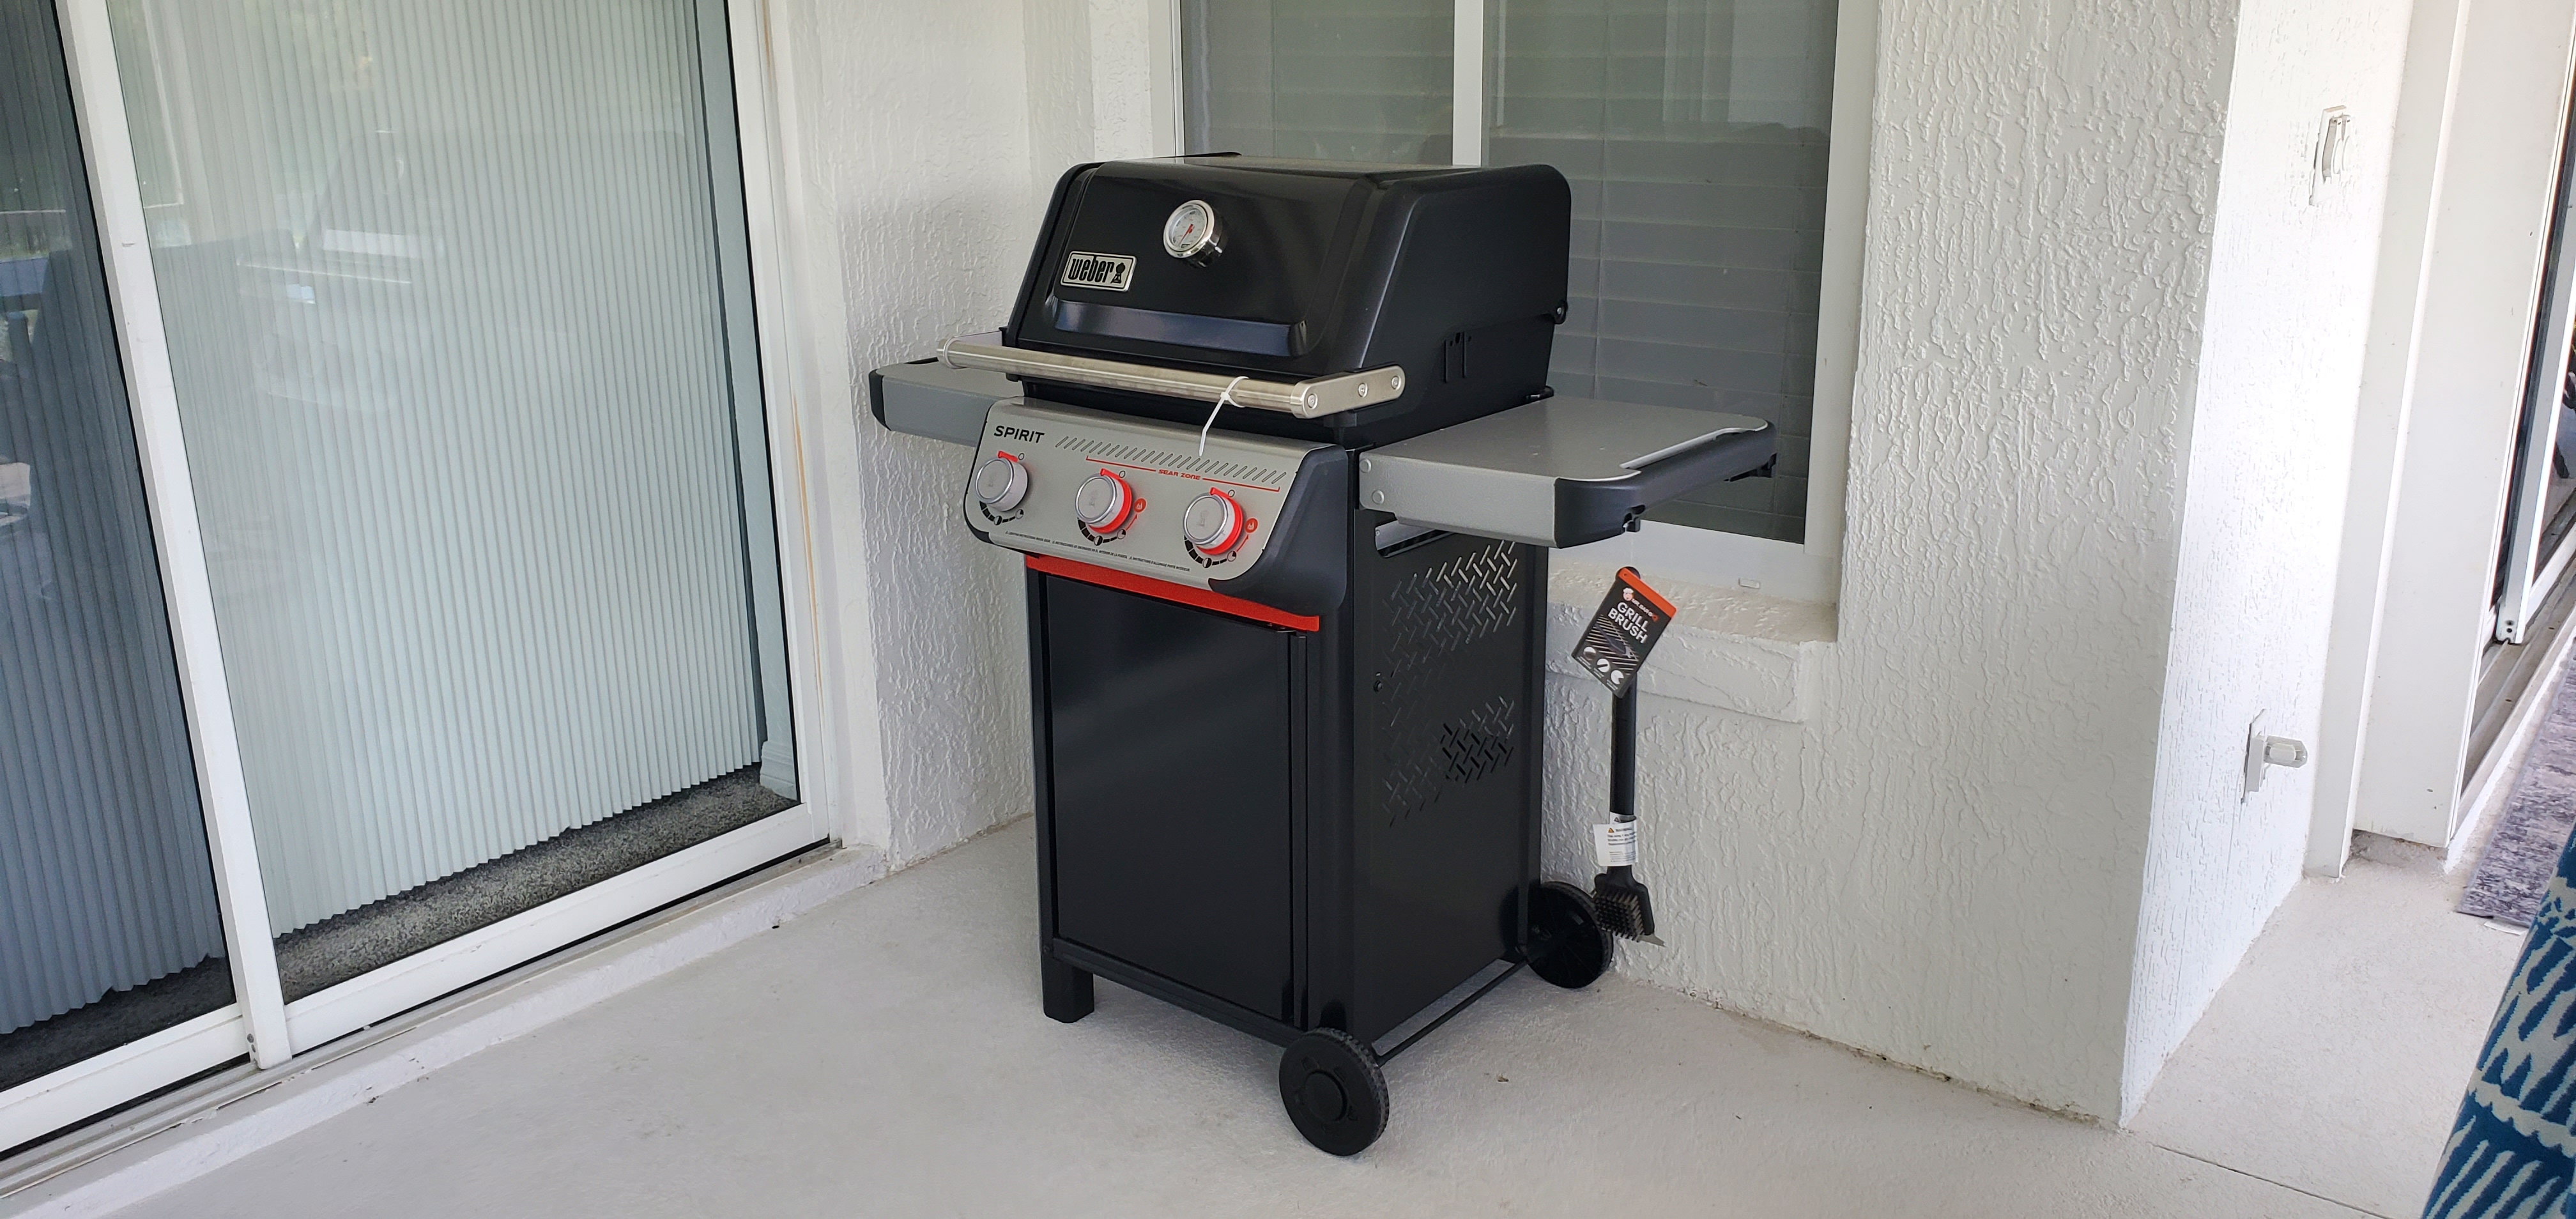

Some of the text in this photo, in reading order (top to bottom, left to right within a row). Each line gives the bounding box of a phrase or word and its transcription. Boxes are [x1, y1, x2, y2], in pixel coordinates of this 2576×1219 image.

[1068, 256, 1115, 283] weber
[993, 425, 1045, 443] SPIRIT
[1158, 469, 1201, 480] SEAR ZONE
[1607, 607, 1648, 644] BRUSH
[1617, 602, 1648, 632] GRILL
